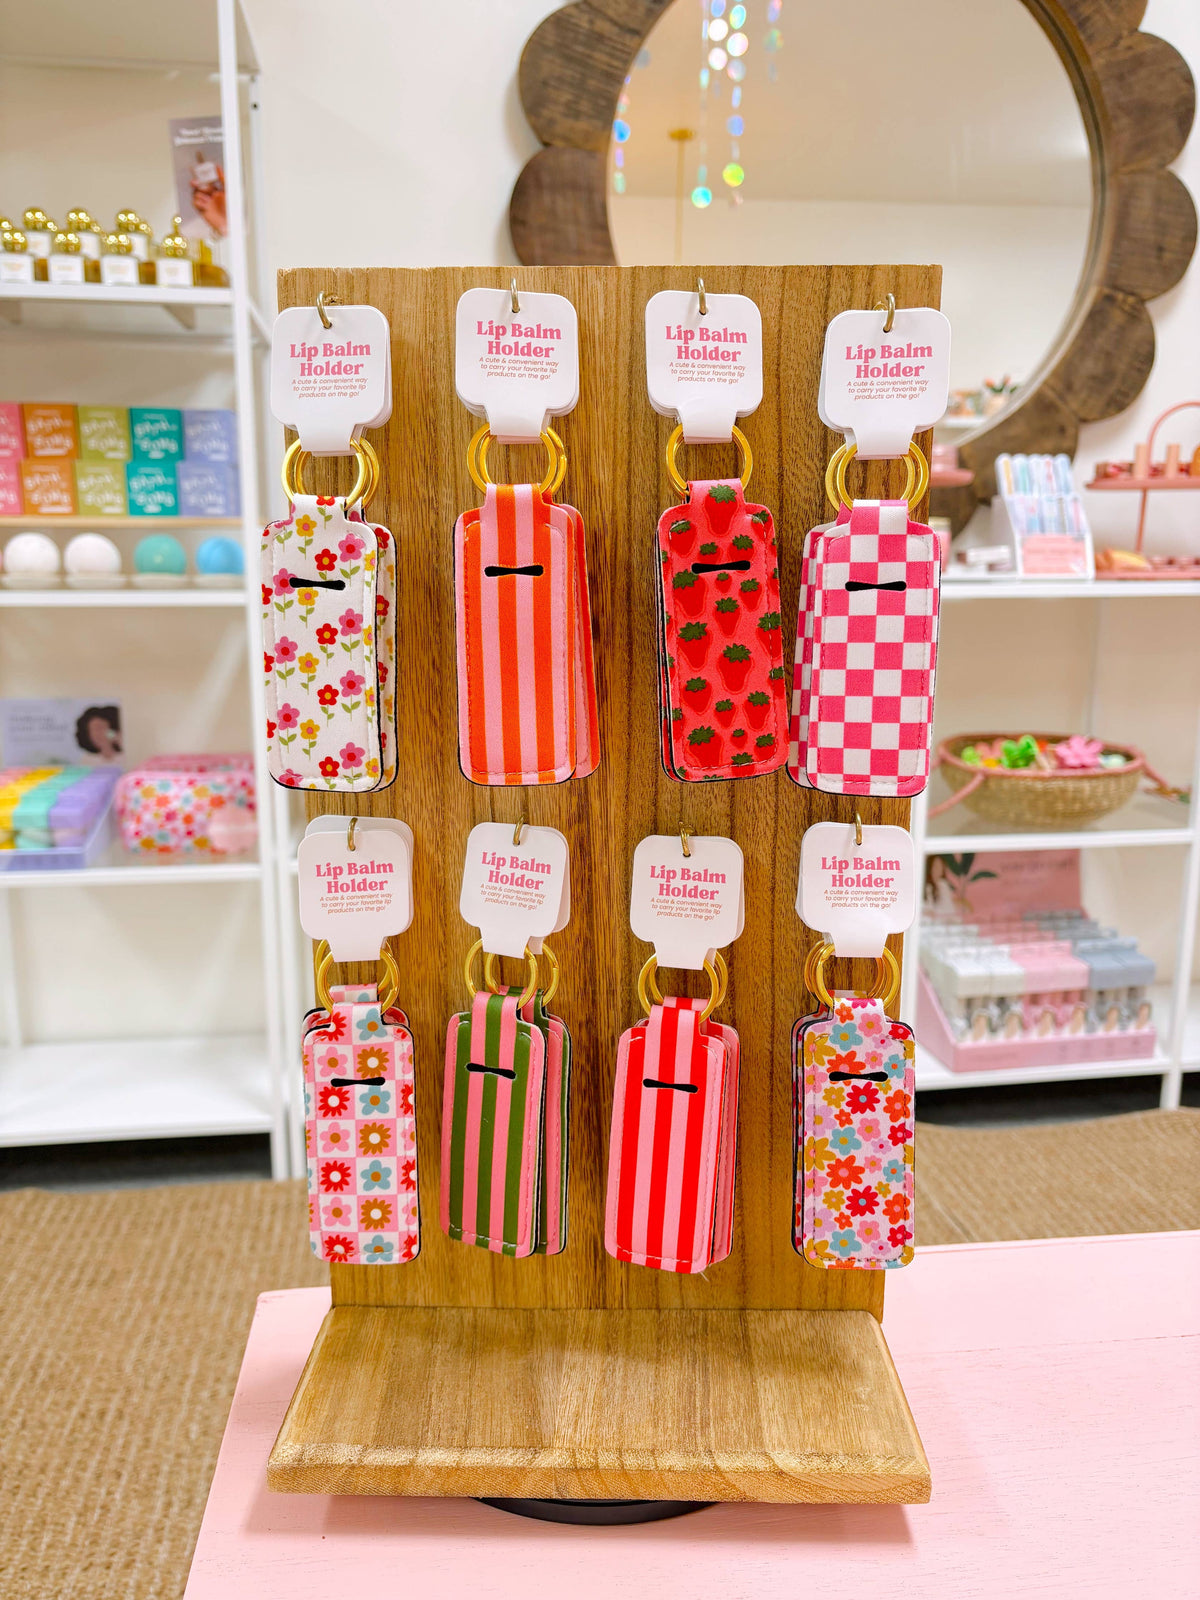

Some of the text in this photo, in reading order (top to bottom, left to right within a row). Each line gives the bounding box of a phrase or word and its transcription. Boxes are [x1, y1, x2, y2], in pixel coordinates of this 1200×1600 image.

[477, 320, 561, 340] Lip Balm
[666, 325, 747, 344] Lip Balm
[290, 341, 371, 361] Lip Balm
[488, 341, 554, 358] Holder
[677, 345, 741, 362] Holder
[846, 343, 932, 363] Lip Balm
[300, 361, 364, 376] Holder
[856, 362, 924, 378] Holder
[316, 860, 394, 880] Lip Balm
[482, 852, 551, 874] Lip Balm
[822, 856, 900, 873] Lip Balm
[488, 870, 544, 890] Holder
[650, 865, 726, 883] Lip Balm
[832, 874, 894, 887] Holder
[327, 878, 388, 893] Holder
[659, 883, 719, 900] Holder
